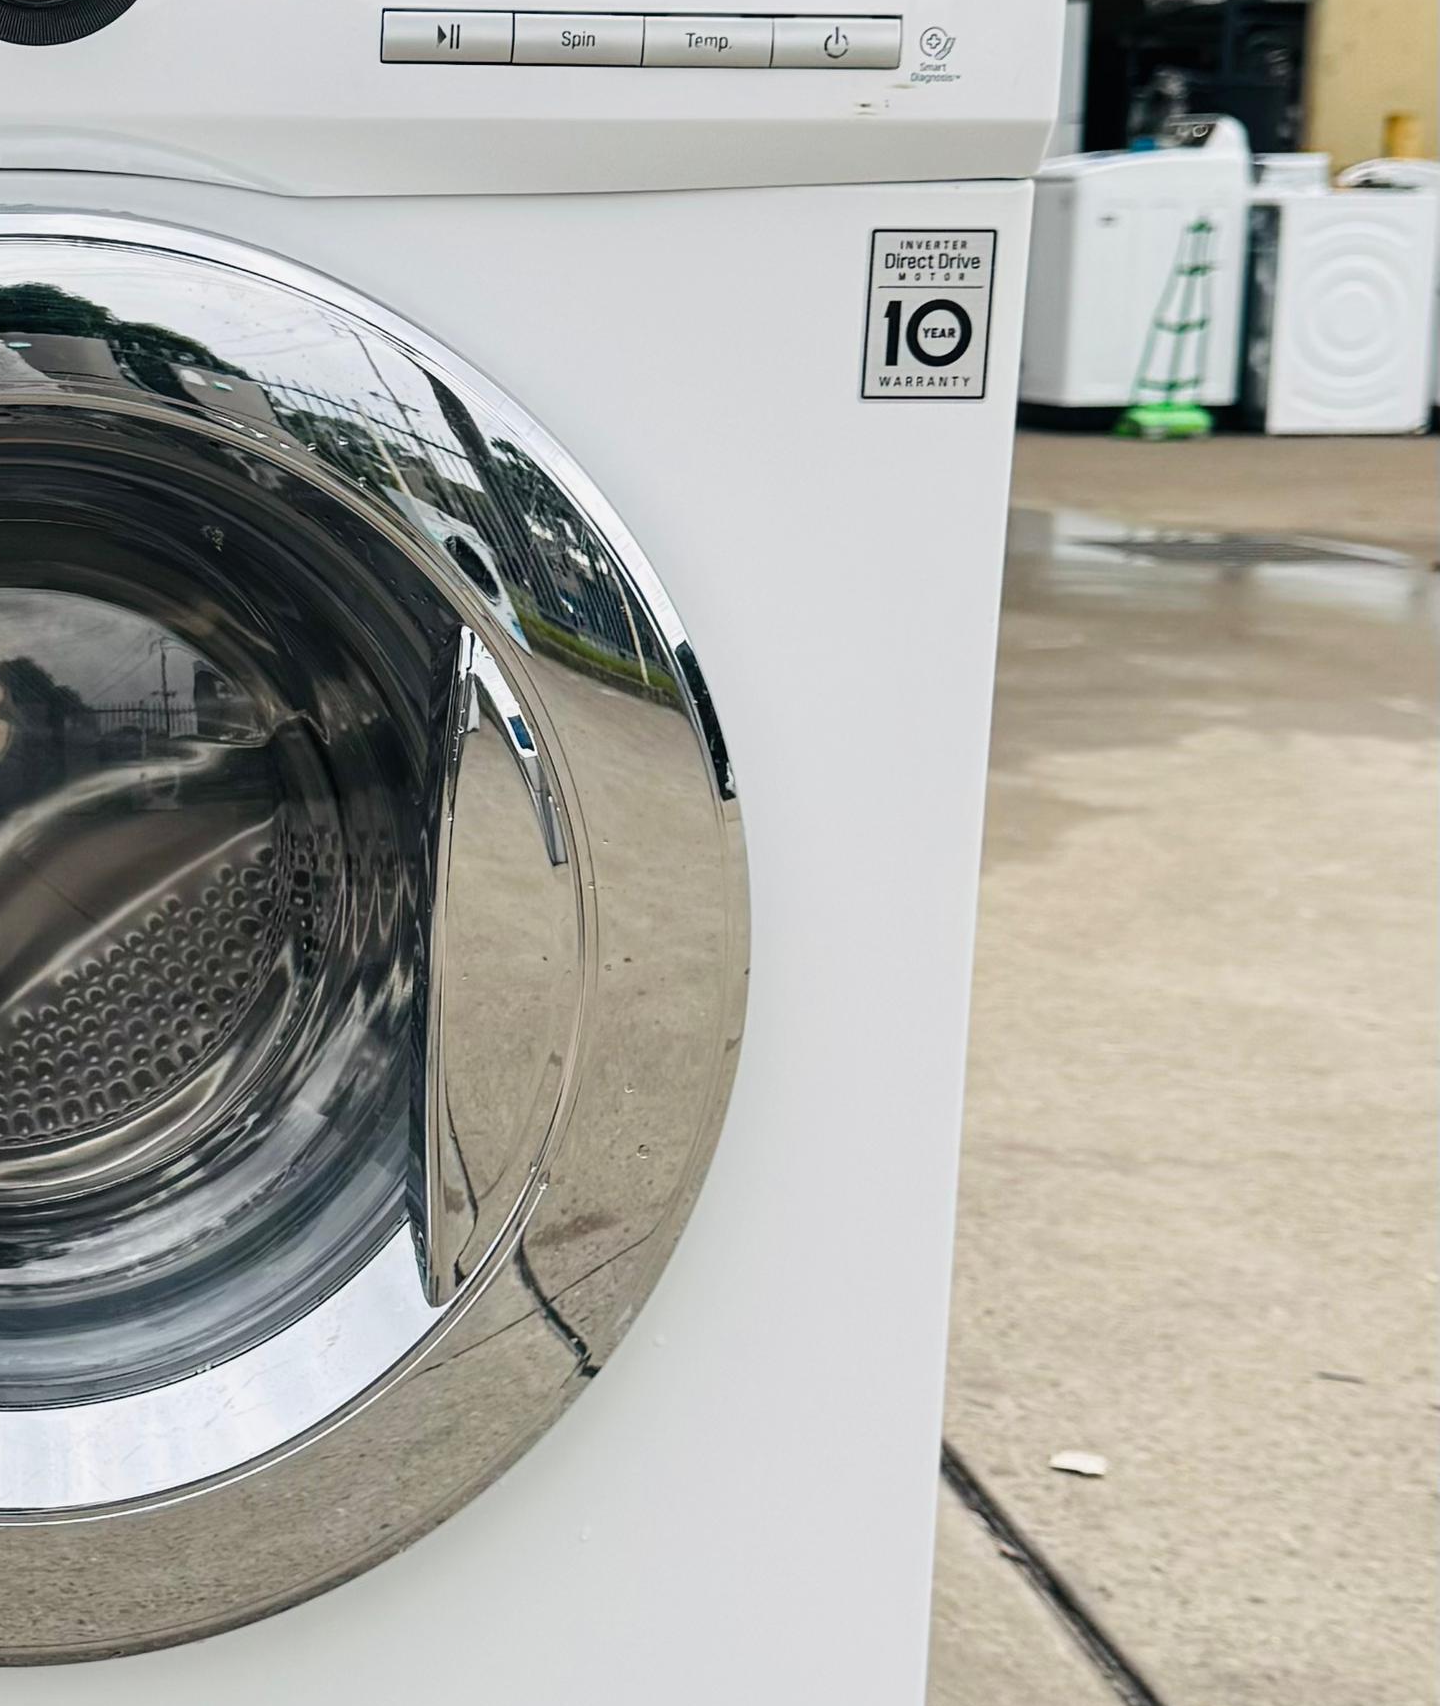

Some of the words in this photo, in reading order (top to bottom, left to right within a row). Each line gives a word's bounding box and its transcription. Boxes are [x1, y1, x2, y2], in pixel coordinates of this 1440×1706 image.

[561, 31, 596, 52] Spin
[686, 33, 732, 53] Temp.
[920, 62, 946, 72] Smart
[900, 240, 968, 250] INVERTER
[885, 253, 934, 269] Direct
[938, 253, 981, 270] Drive
[898, 273, 965, 281] MOTOR
[884, 299, 972, 367] 10
[922, 328, 956, 339] YEAR
[879, 376, 971, 387] WARRANTY
